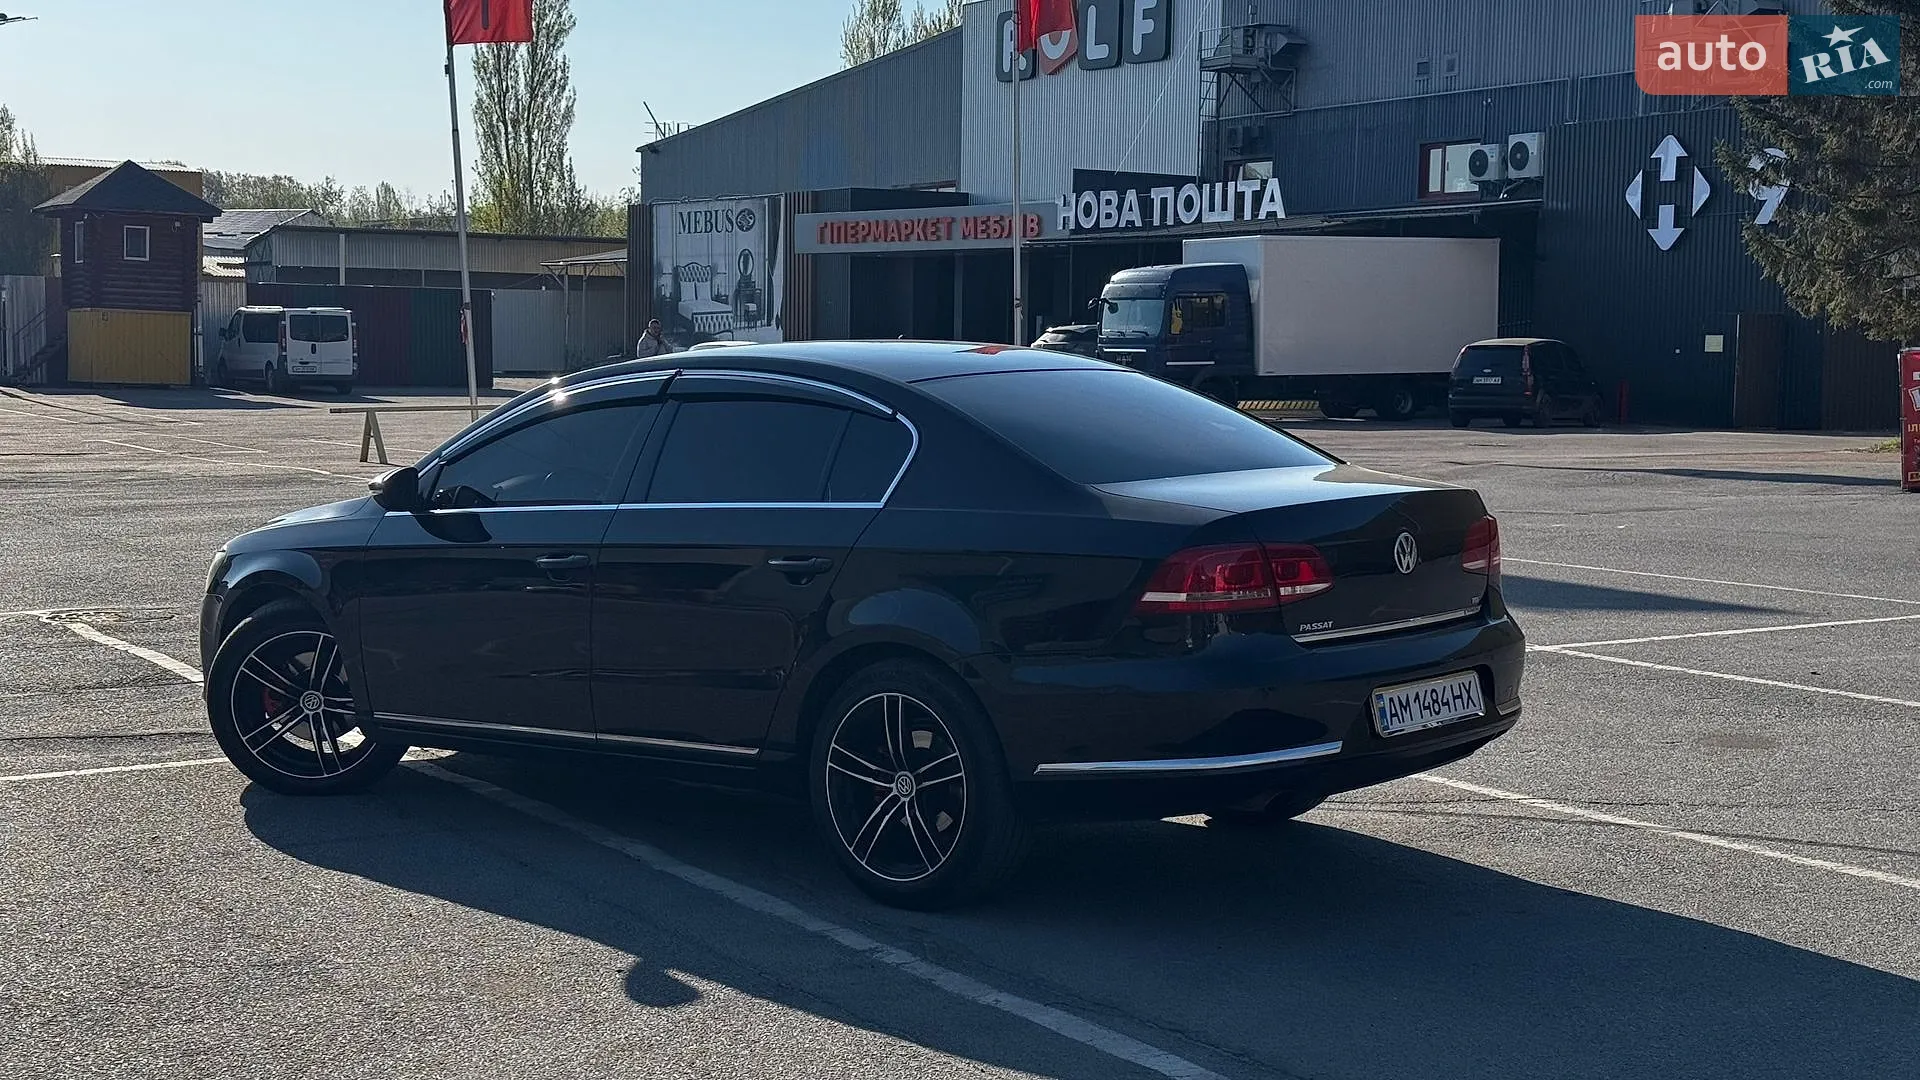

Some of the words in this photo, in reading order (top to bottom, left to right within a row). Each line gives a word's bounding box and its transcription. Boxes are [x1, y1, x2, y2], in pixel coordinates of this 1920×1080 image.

[1056, 189, 1142, 230] НОВА
[1151, 178, 1287, 226] ПОШТА
[678, 208, 734, 234] MEBUS
[816, 217, 955, 244] ГІПЕРМАРКЕТ
[960, 213, 1040, 241] МЕБЛІВ
[1299, 621, 1333, 632] PASSAT
